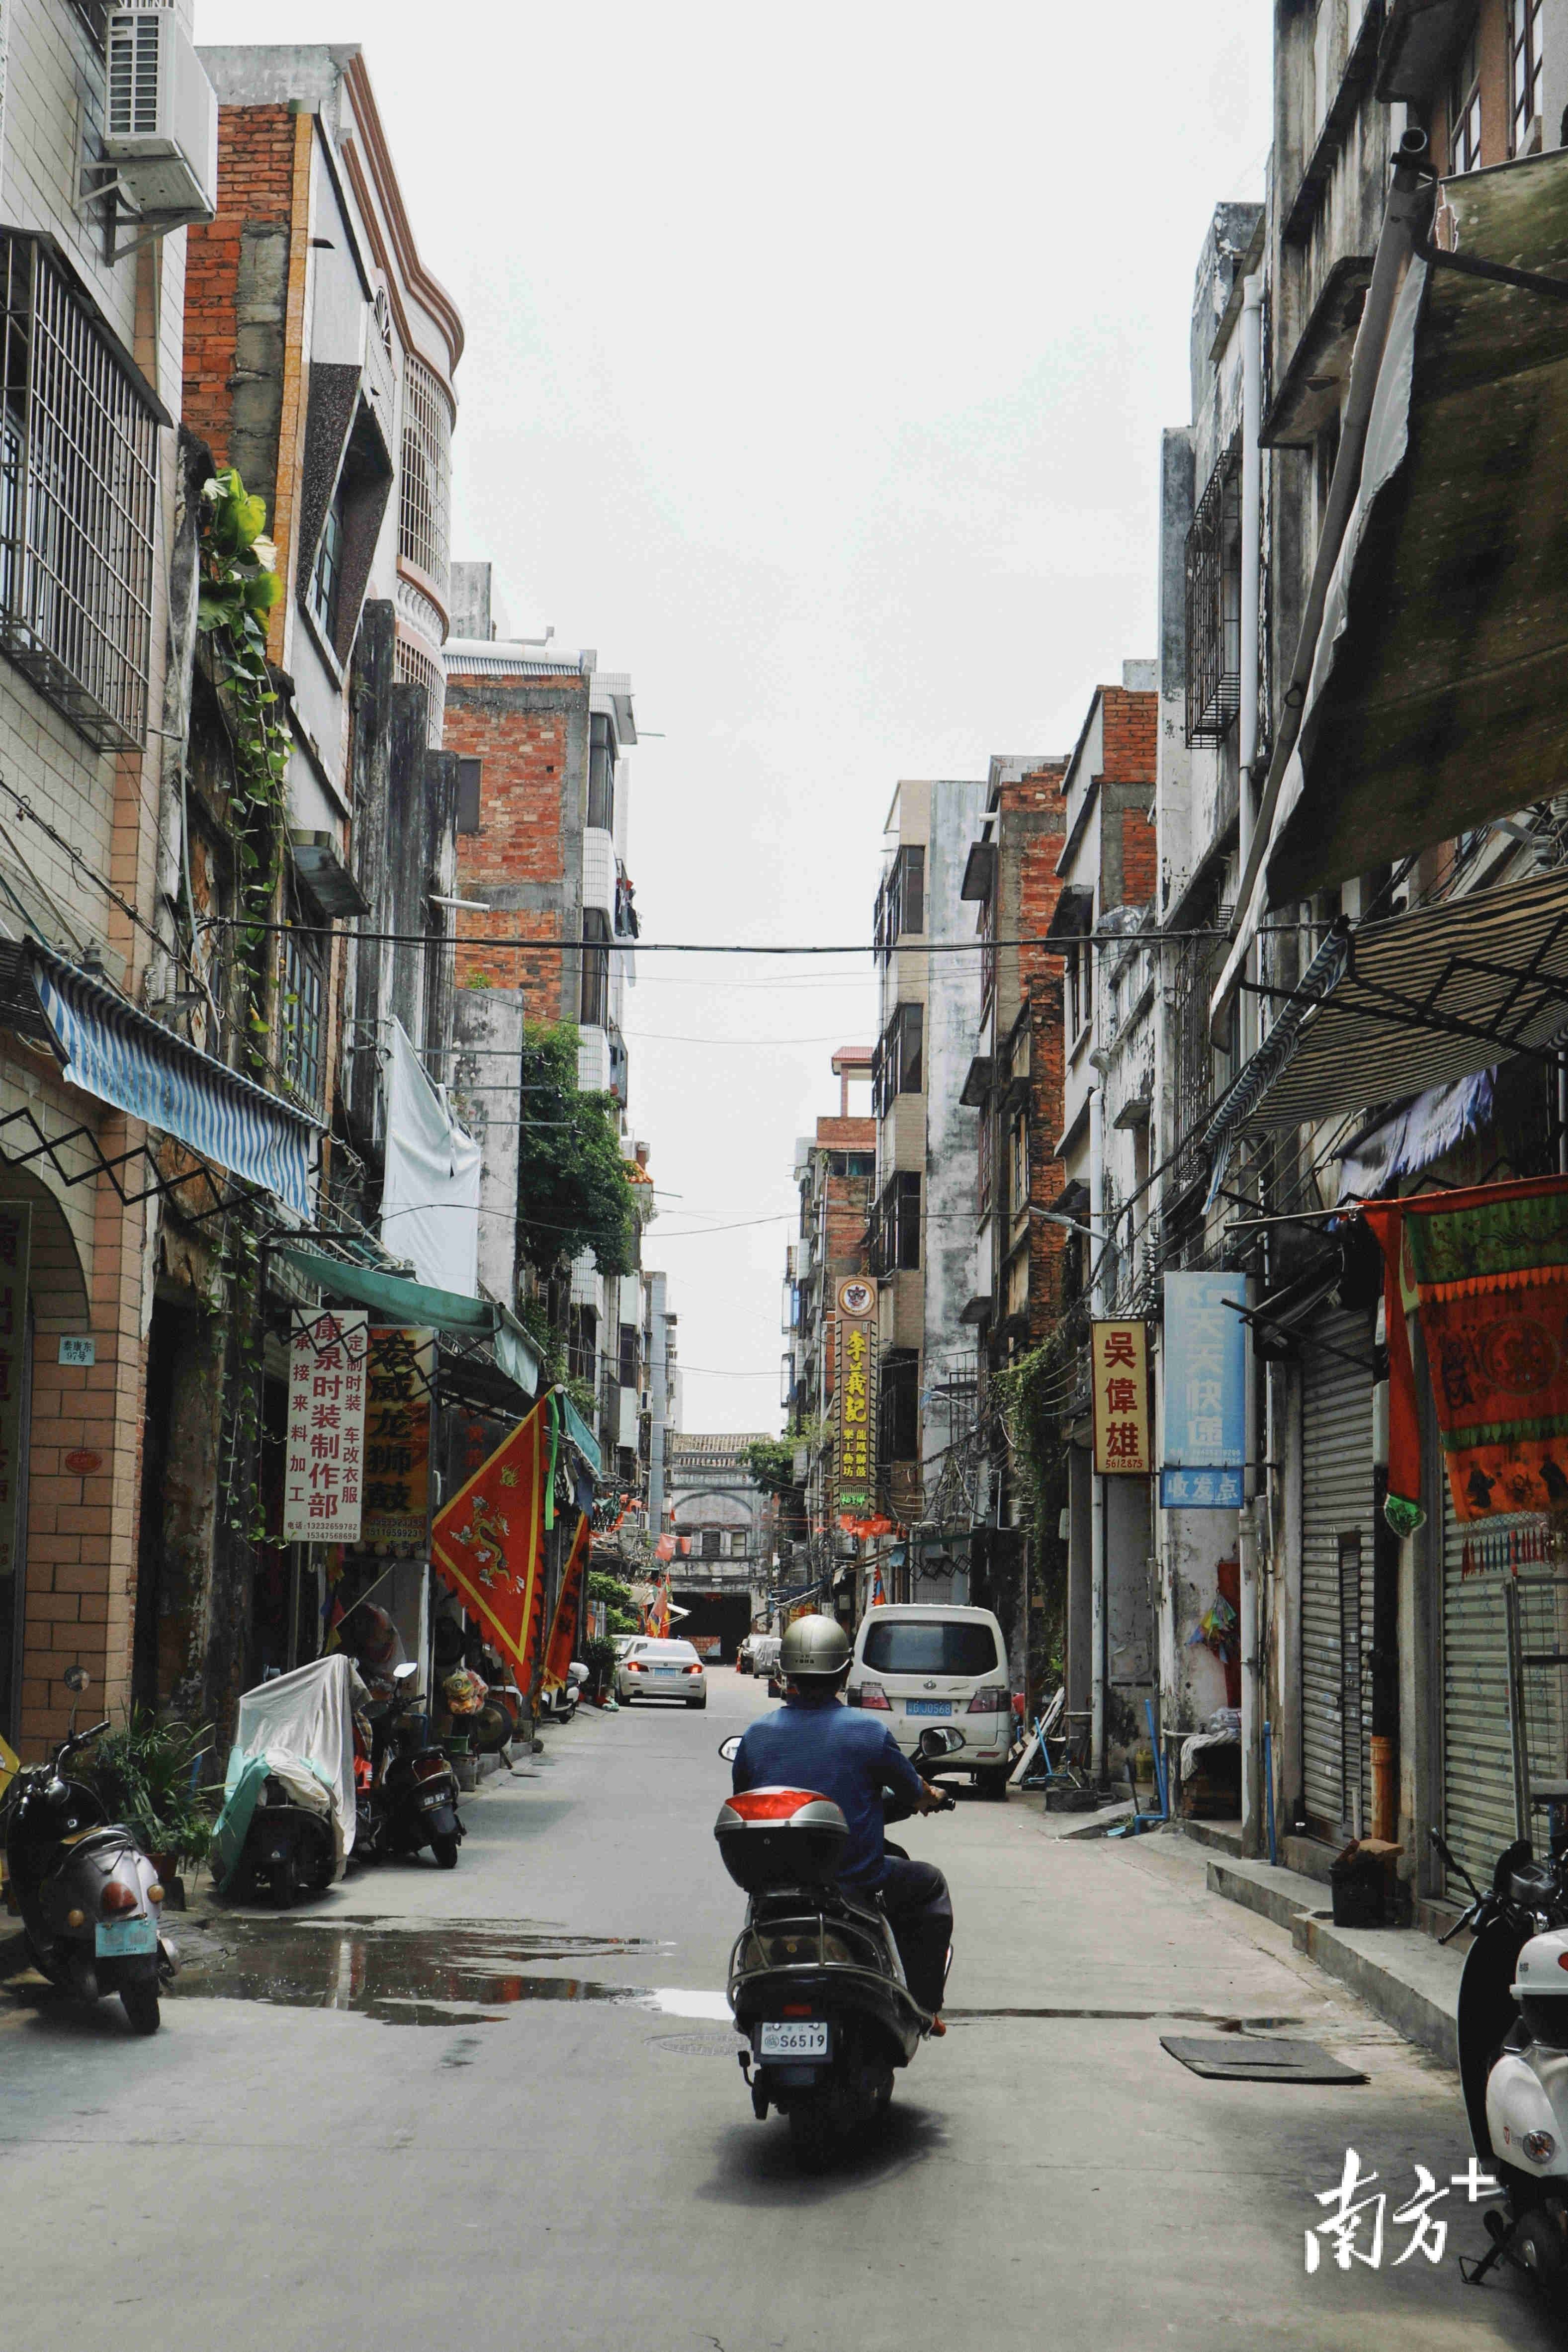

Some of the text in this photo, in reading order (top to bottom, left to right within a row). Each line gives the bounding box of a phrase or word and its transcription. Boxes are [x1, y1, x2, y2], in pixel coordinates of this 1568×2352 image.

[288, 1333, 311, 1503] 承接来料加工
[1104, 1332, 1139, 1458] 吳偉雄
[1105, 1459, 1143, 1469] 5612875
[1167, 1472, 1238, 1499] 收发点
